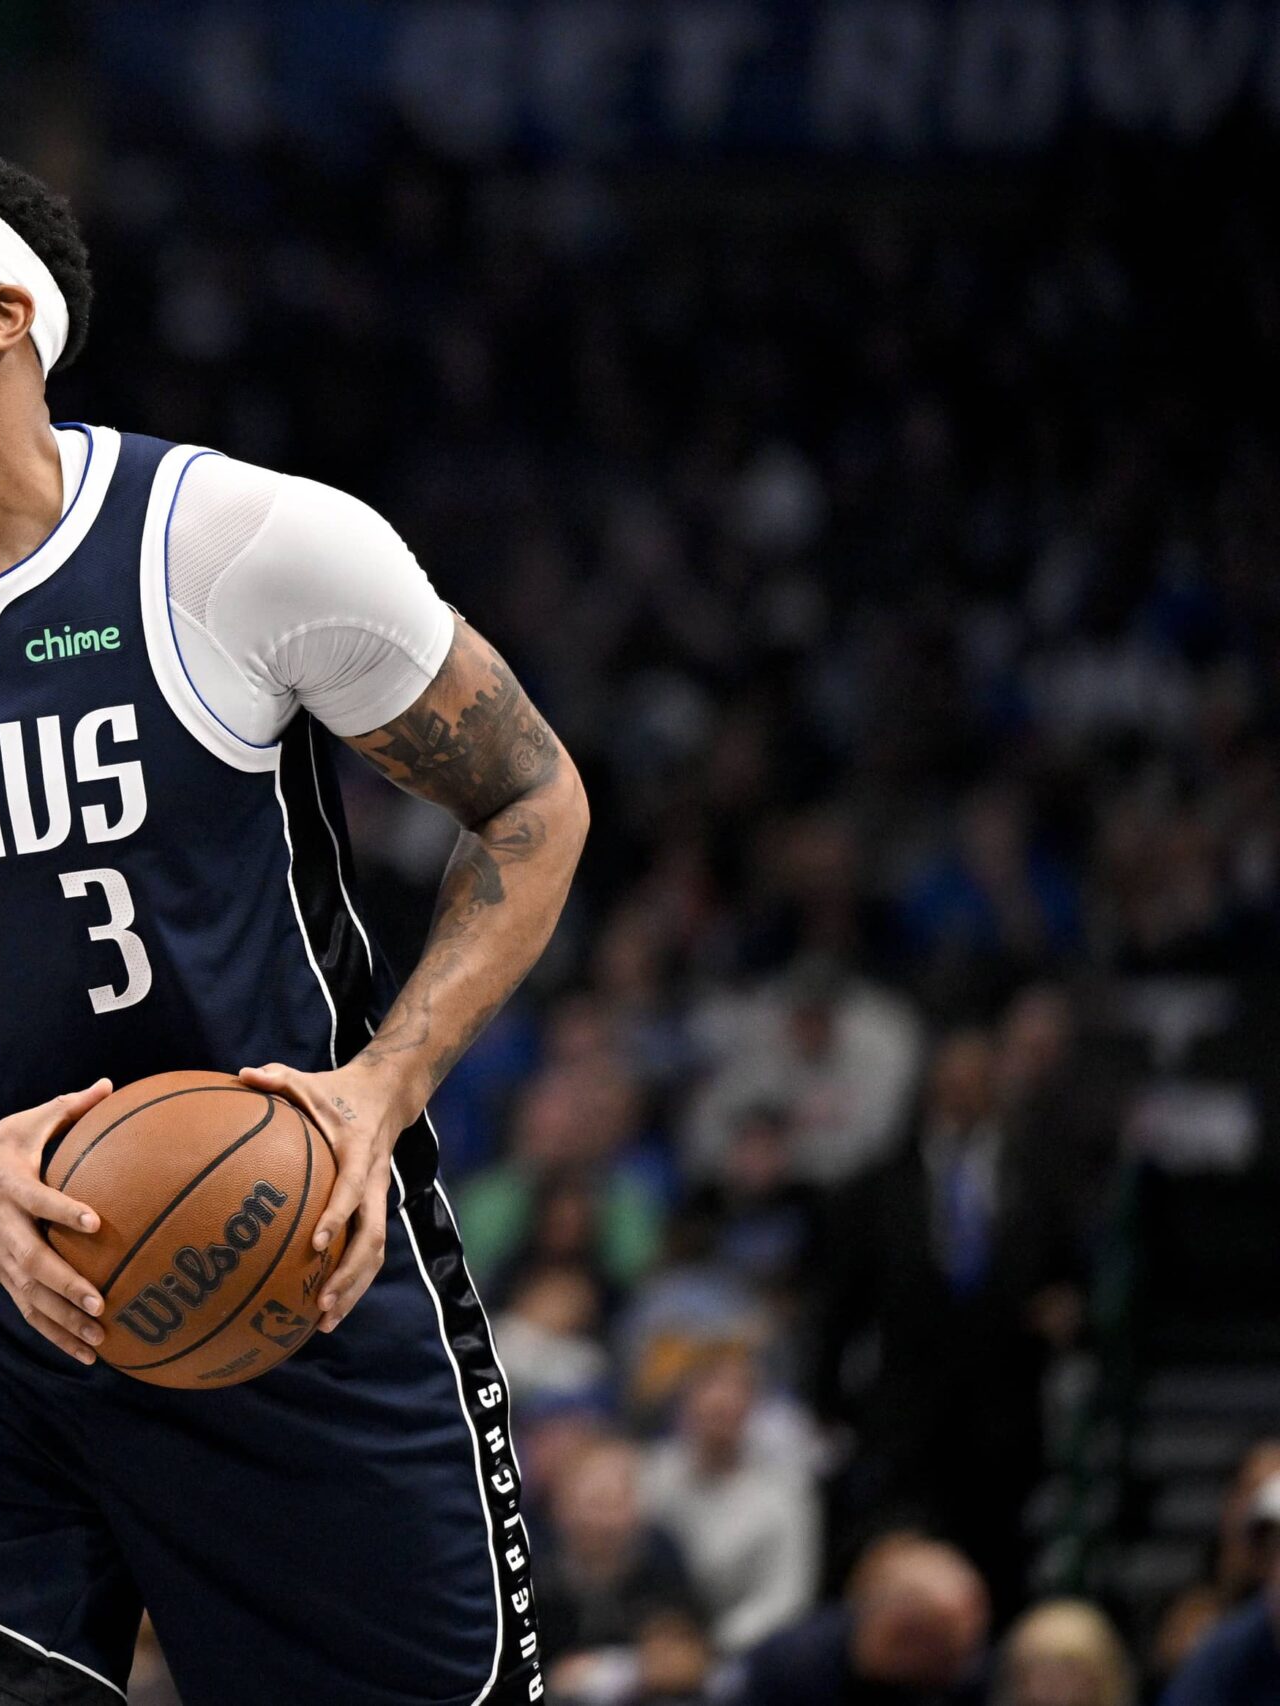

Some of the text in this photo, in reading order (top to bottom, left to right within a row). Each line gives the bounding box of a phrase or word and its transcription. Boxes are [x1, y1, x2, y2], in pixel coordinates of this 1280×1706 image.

[25, 625, 121, 663] chime
[58, 867, 153, 1015] 3
[112, 1180, 288, 1345] Wilson
